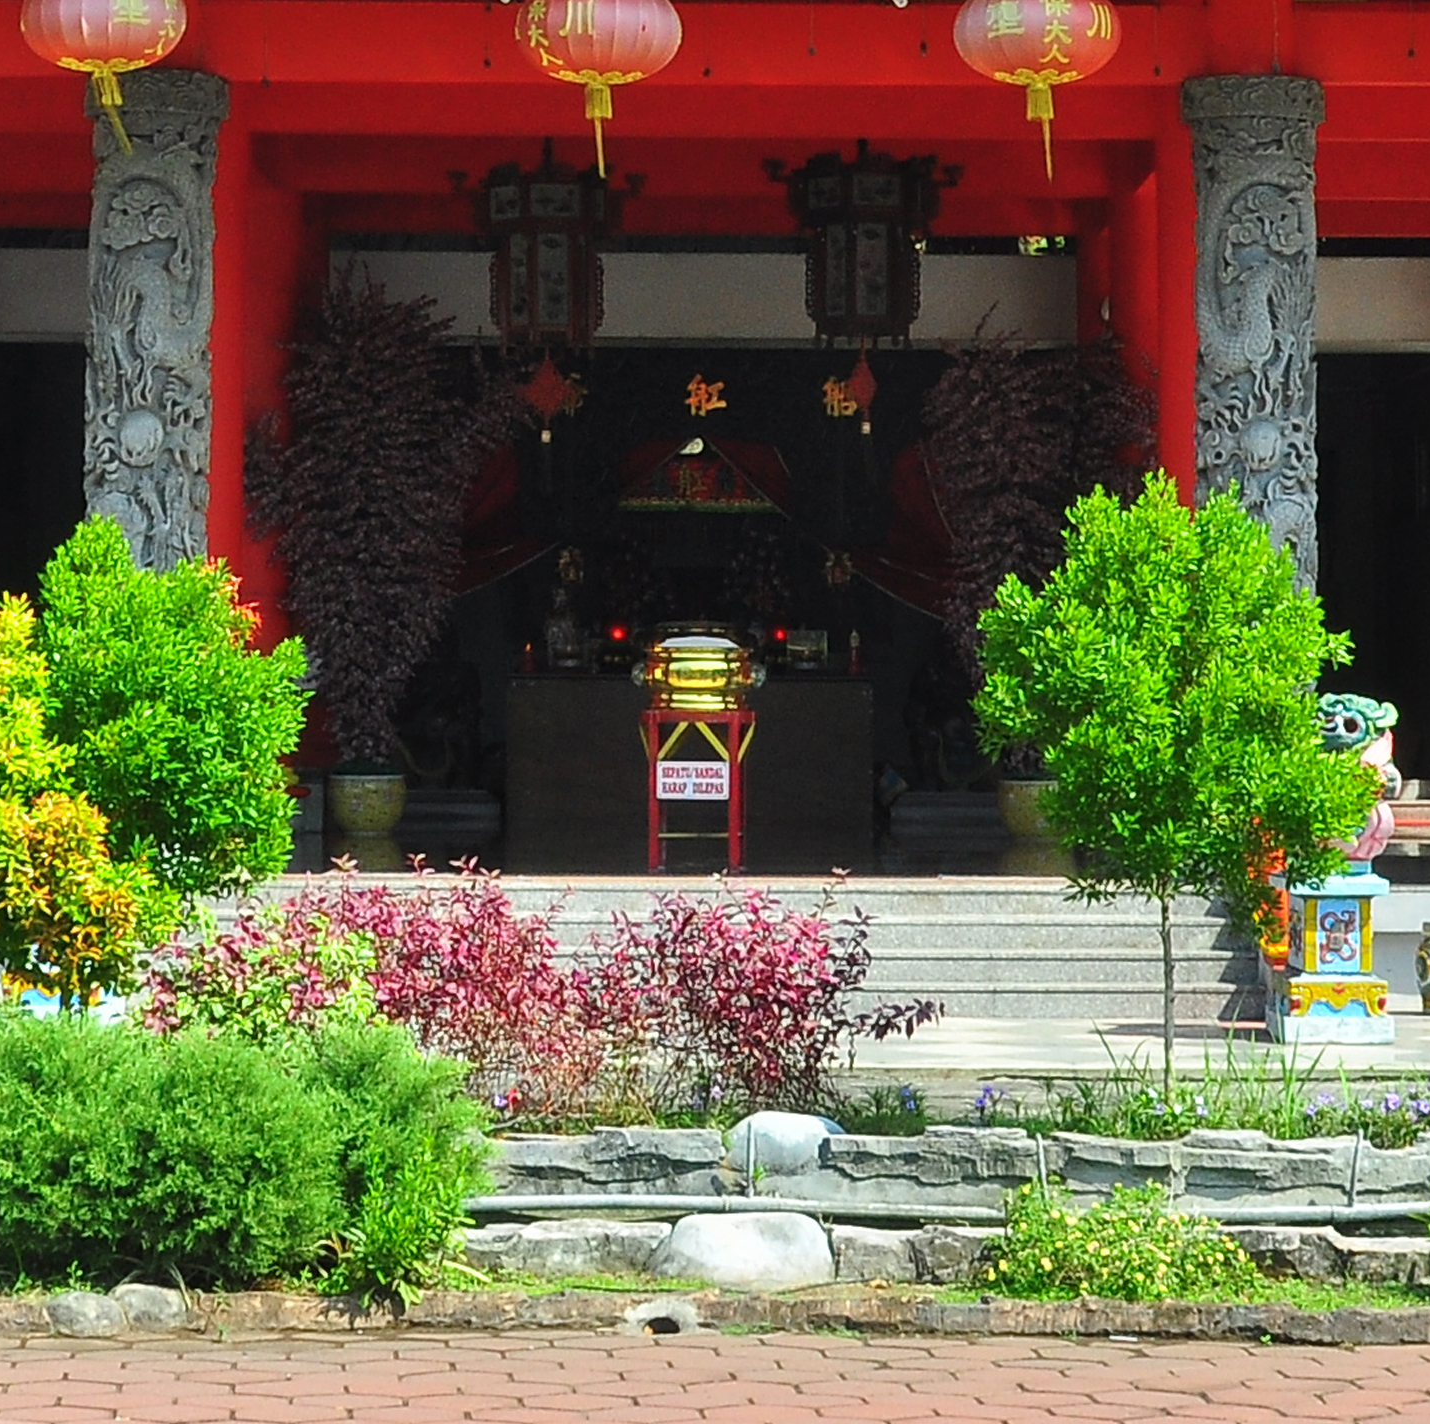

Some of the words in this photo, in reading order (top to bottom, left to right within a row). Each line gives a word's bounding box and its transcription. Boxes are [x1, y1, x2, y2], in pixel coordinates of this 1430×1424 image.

[1087, 1, 1113, 40] 川
[661, 766, 723, 779] SEPATU/SANDAL
[661, 781, 687, 794] HARAP
[692, 781, 724, 794] DILEPAS
